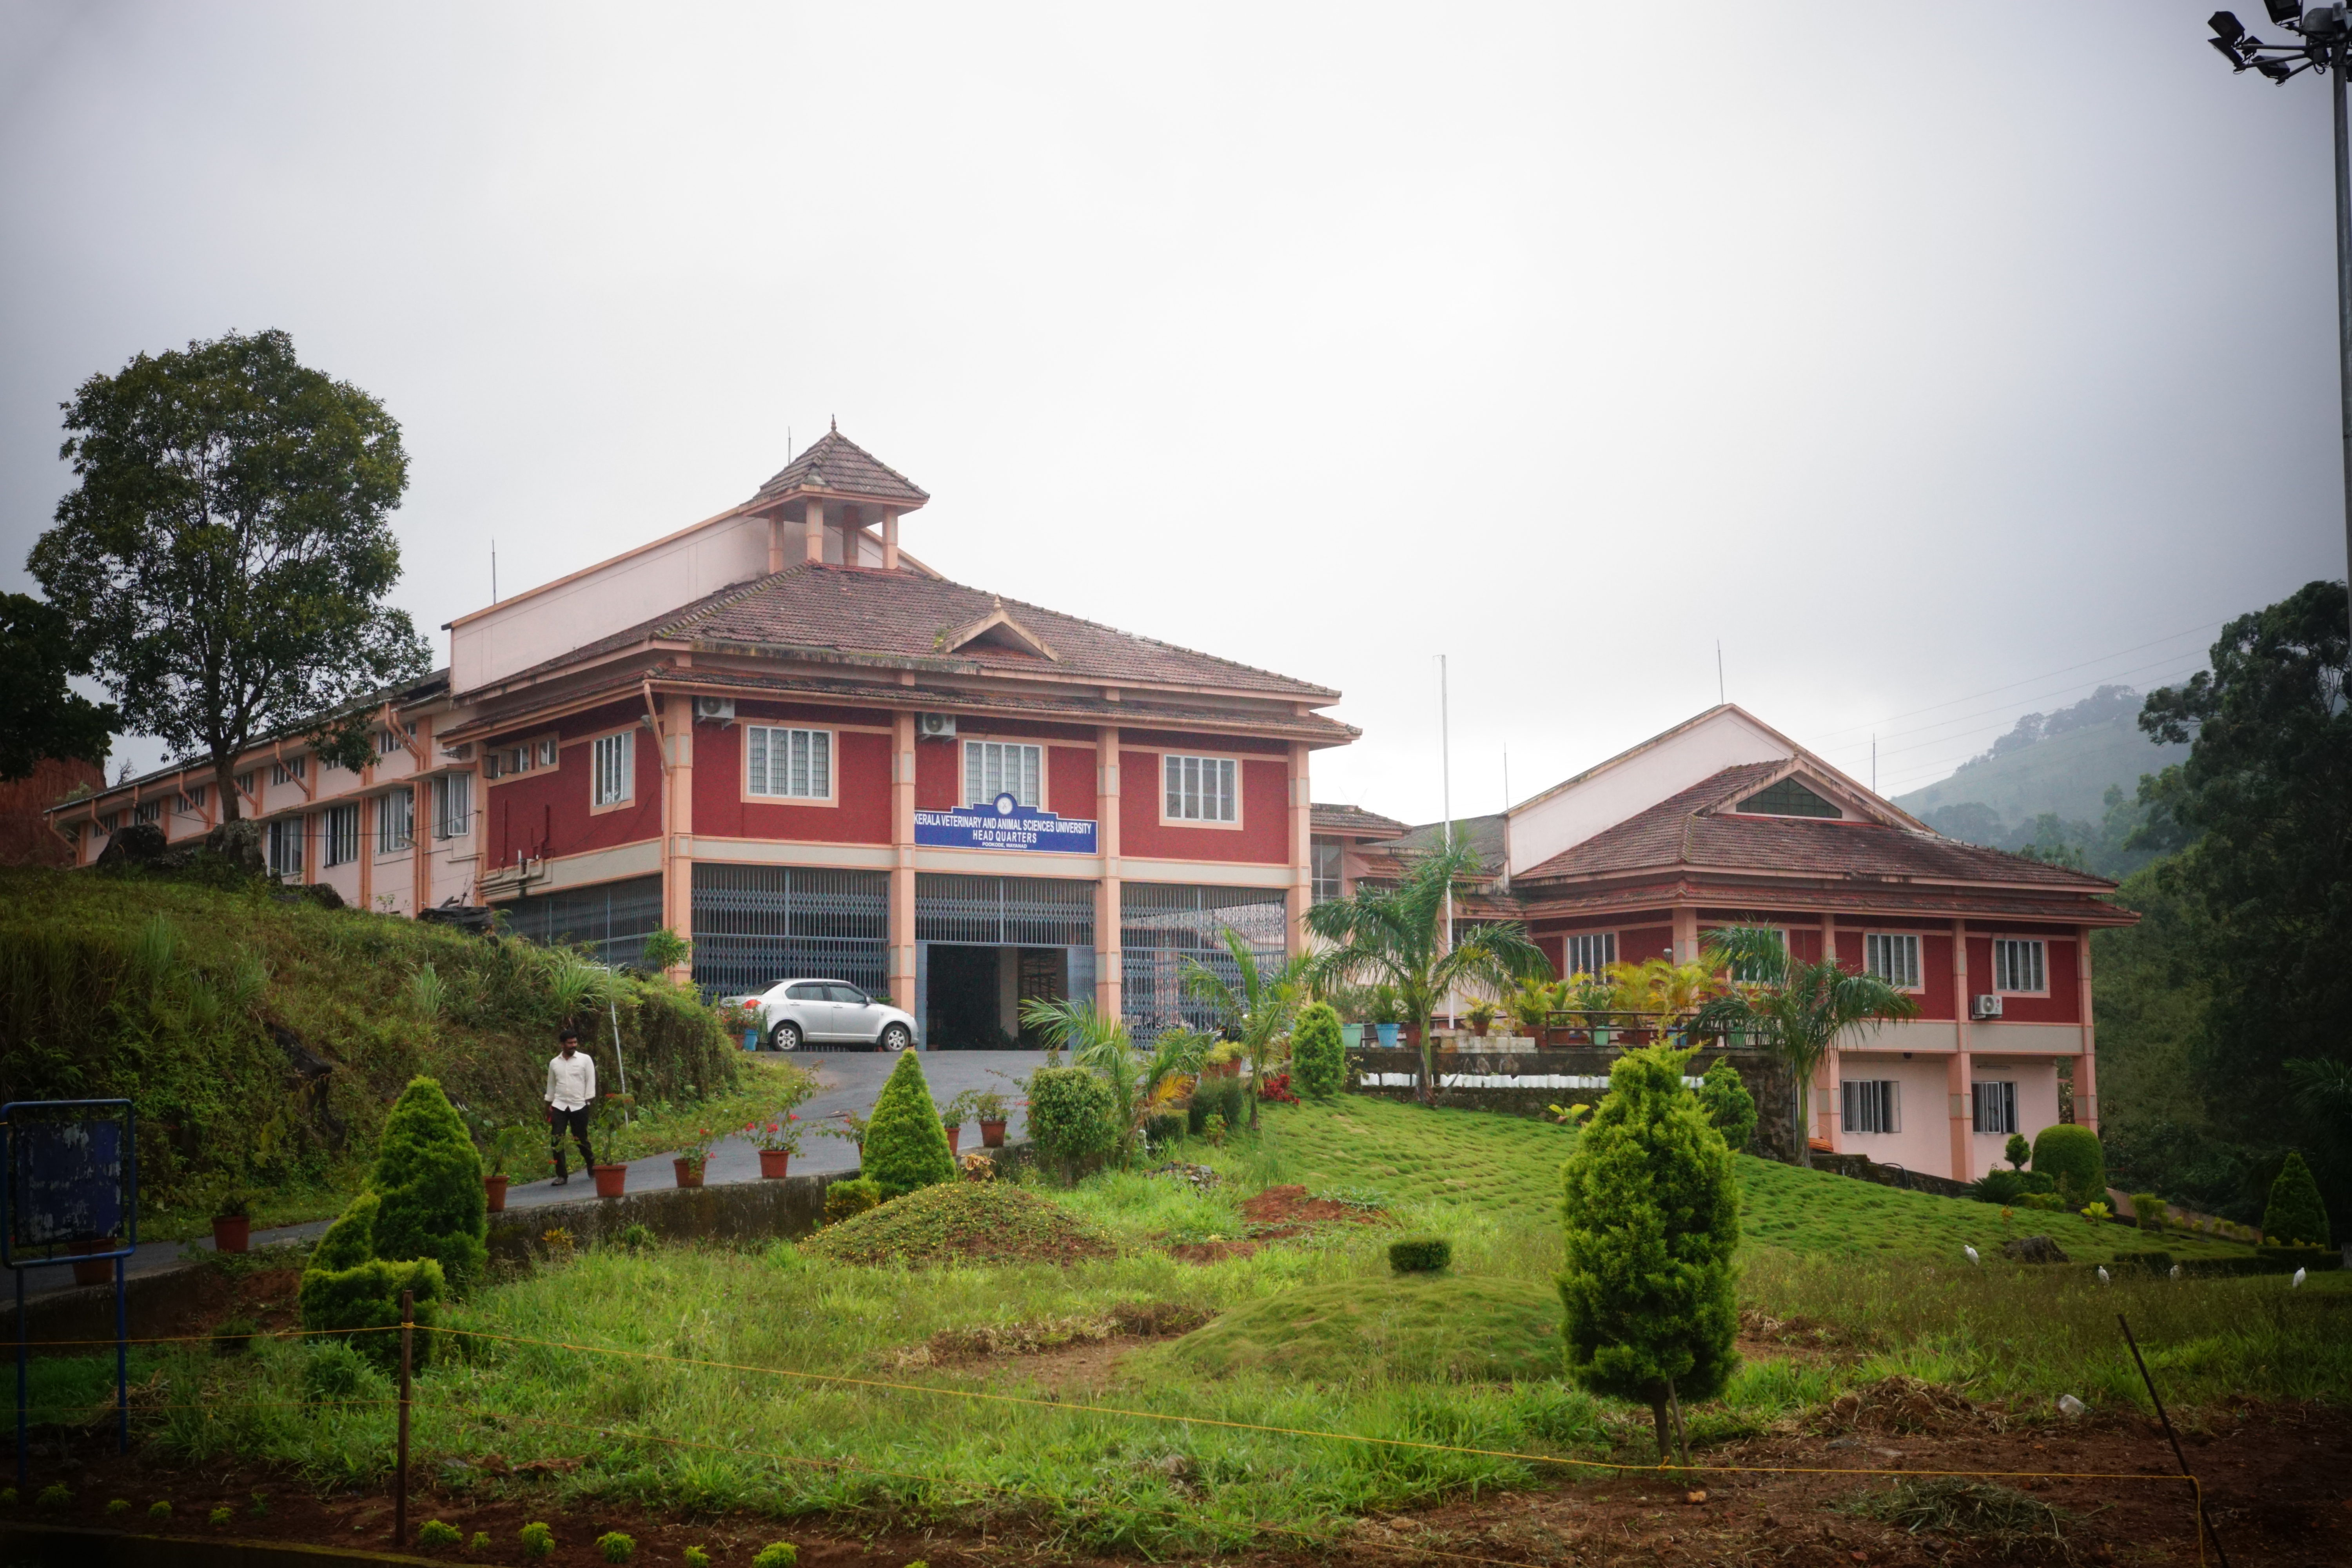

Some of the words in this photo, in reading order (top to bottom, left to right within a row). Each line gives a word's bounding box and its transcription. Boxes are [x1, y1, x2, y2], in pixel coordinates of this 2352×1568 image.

[915, 813, 940, 826] KERALA
[942, 815, 981, 828] VETERINARY
[983, 818, 996, 829] AND
[997, 818, 1022, 830] ANIMAL
[1023, 820, 1054, 832] SCIENCES
[1056, 822, 1092, 834] UNIVERSITY
[973, 829, 993, 840] HEAD
[996, 831, 1037, 843] QUARTERS
